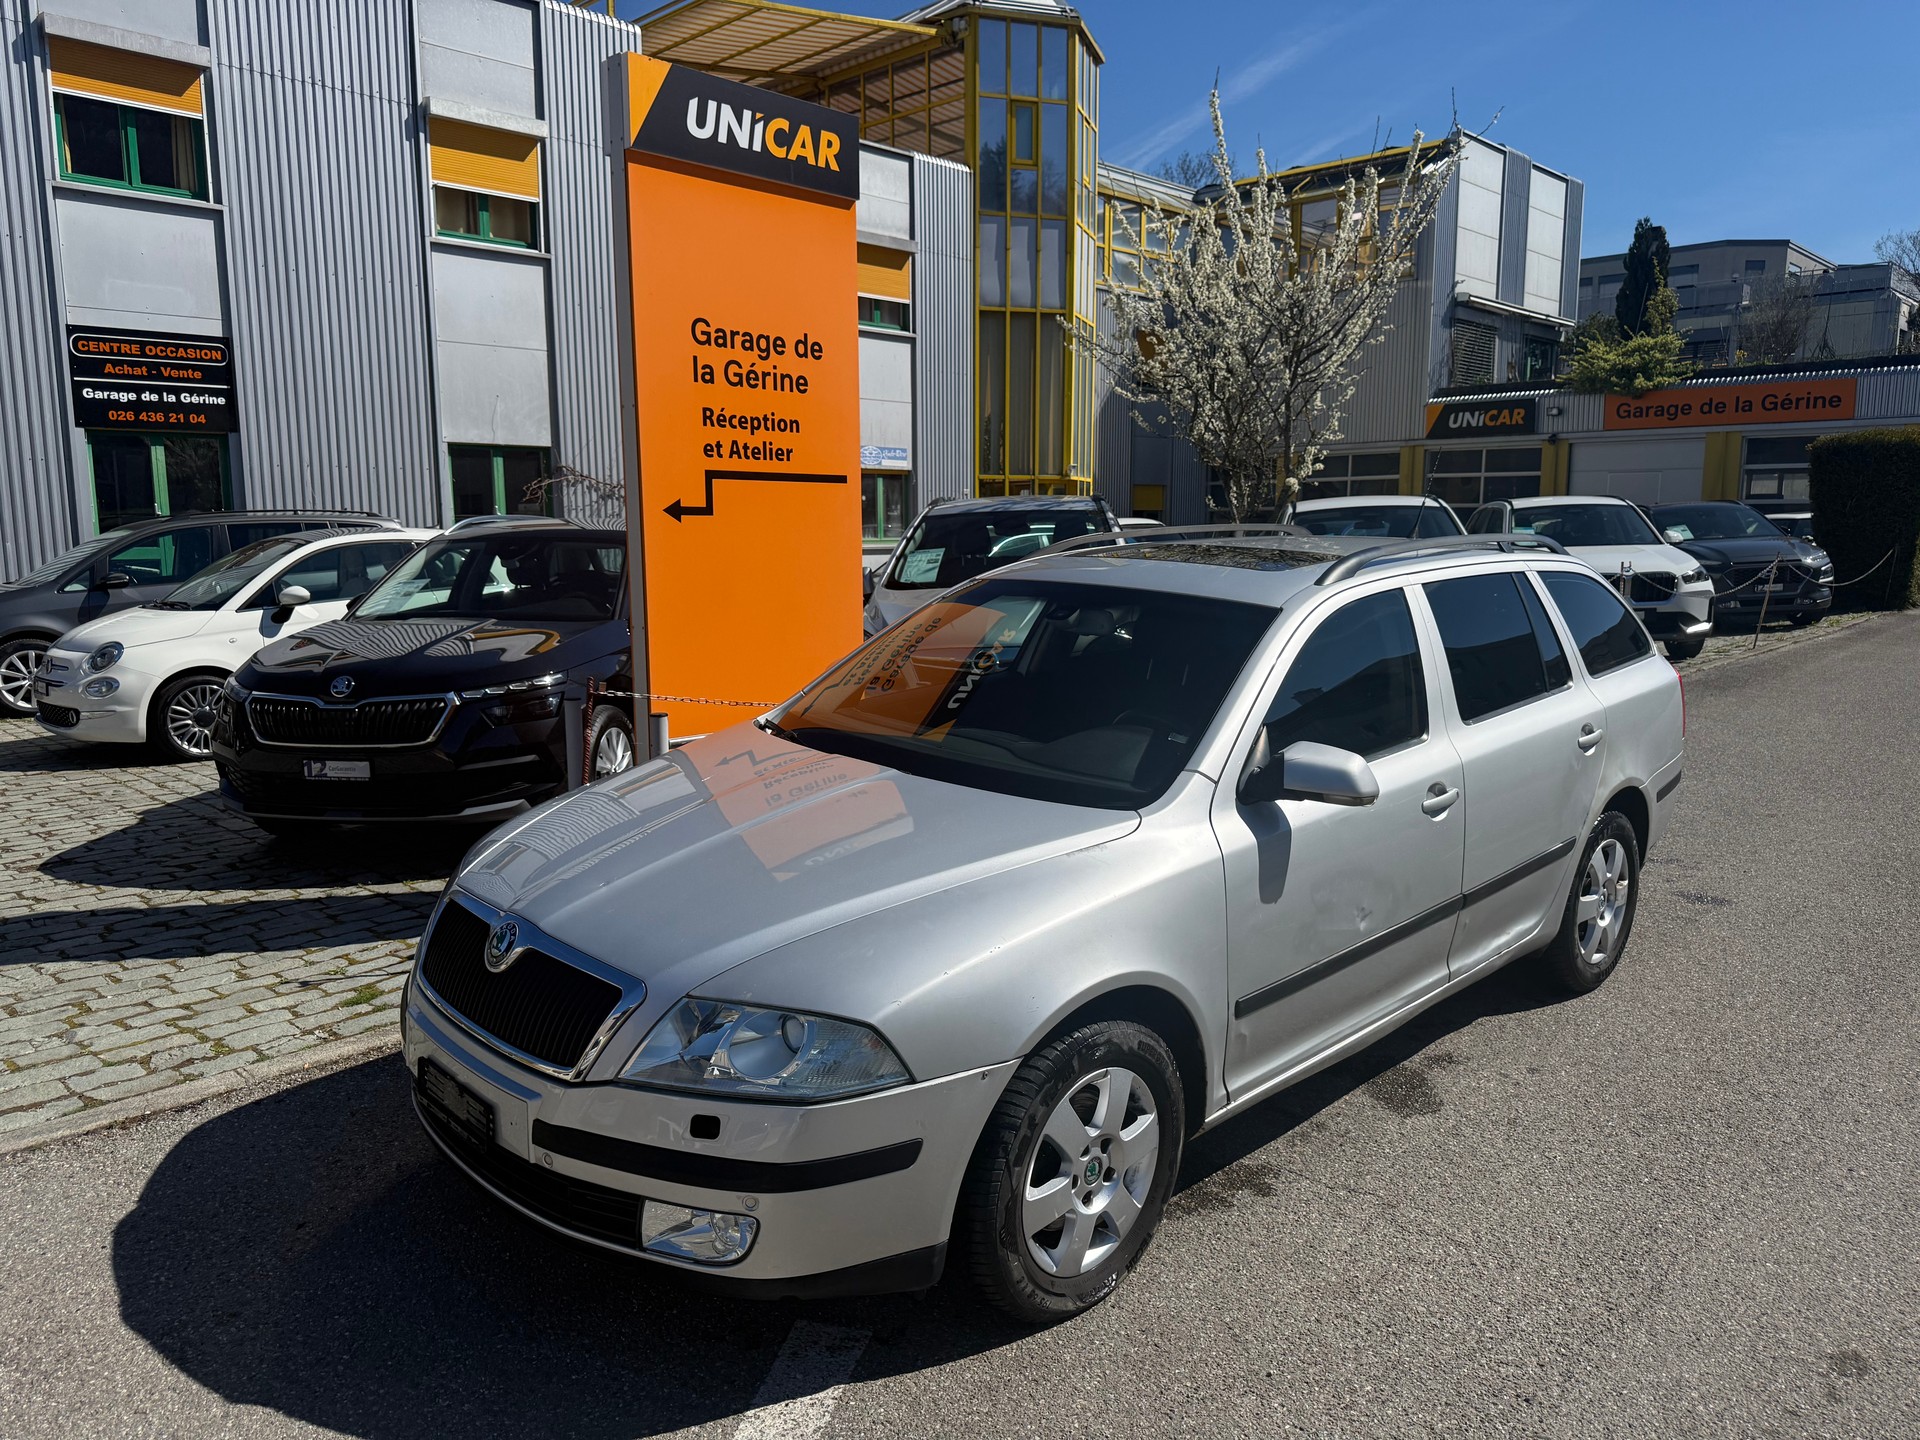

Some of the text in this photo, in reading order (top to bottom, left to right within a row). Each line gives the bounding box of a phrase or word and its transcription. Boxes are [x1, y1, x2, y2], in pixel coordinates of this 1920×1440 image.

[77, 340, 222, 361] CENTRE OCCASION
[690, 317, 824, 361] Garage de
[103, 363, 148, 376] Achat
[160, 366, 202, 379] Vente
[692, 355, 809, 395] la Gérine
[82, 387, 226, 405] Garage de la Gérine
[1616, 392, 1842, 421] Garage de la Gérine
[108, 410, 207, 424] 026 436 21 04
[702, 407, 800, 436] Réception
[703, 439, 794, 462] et Atelier
